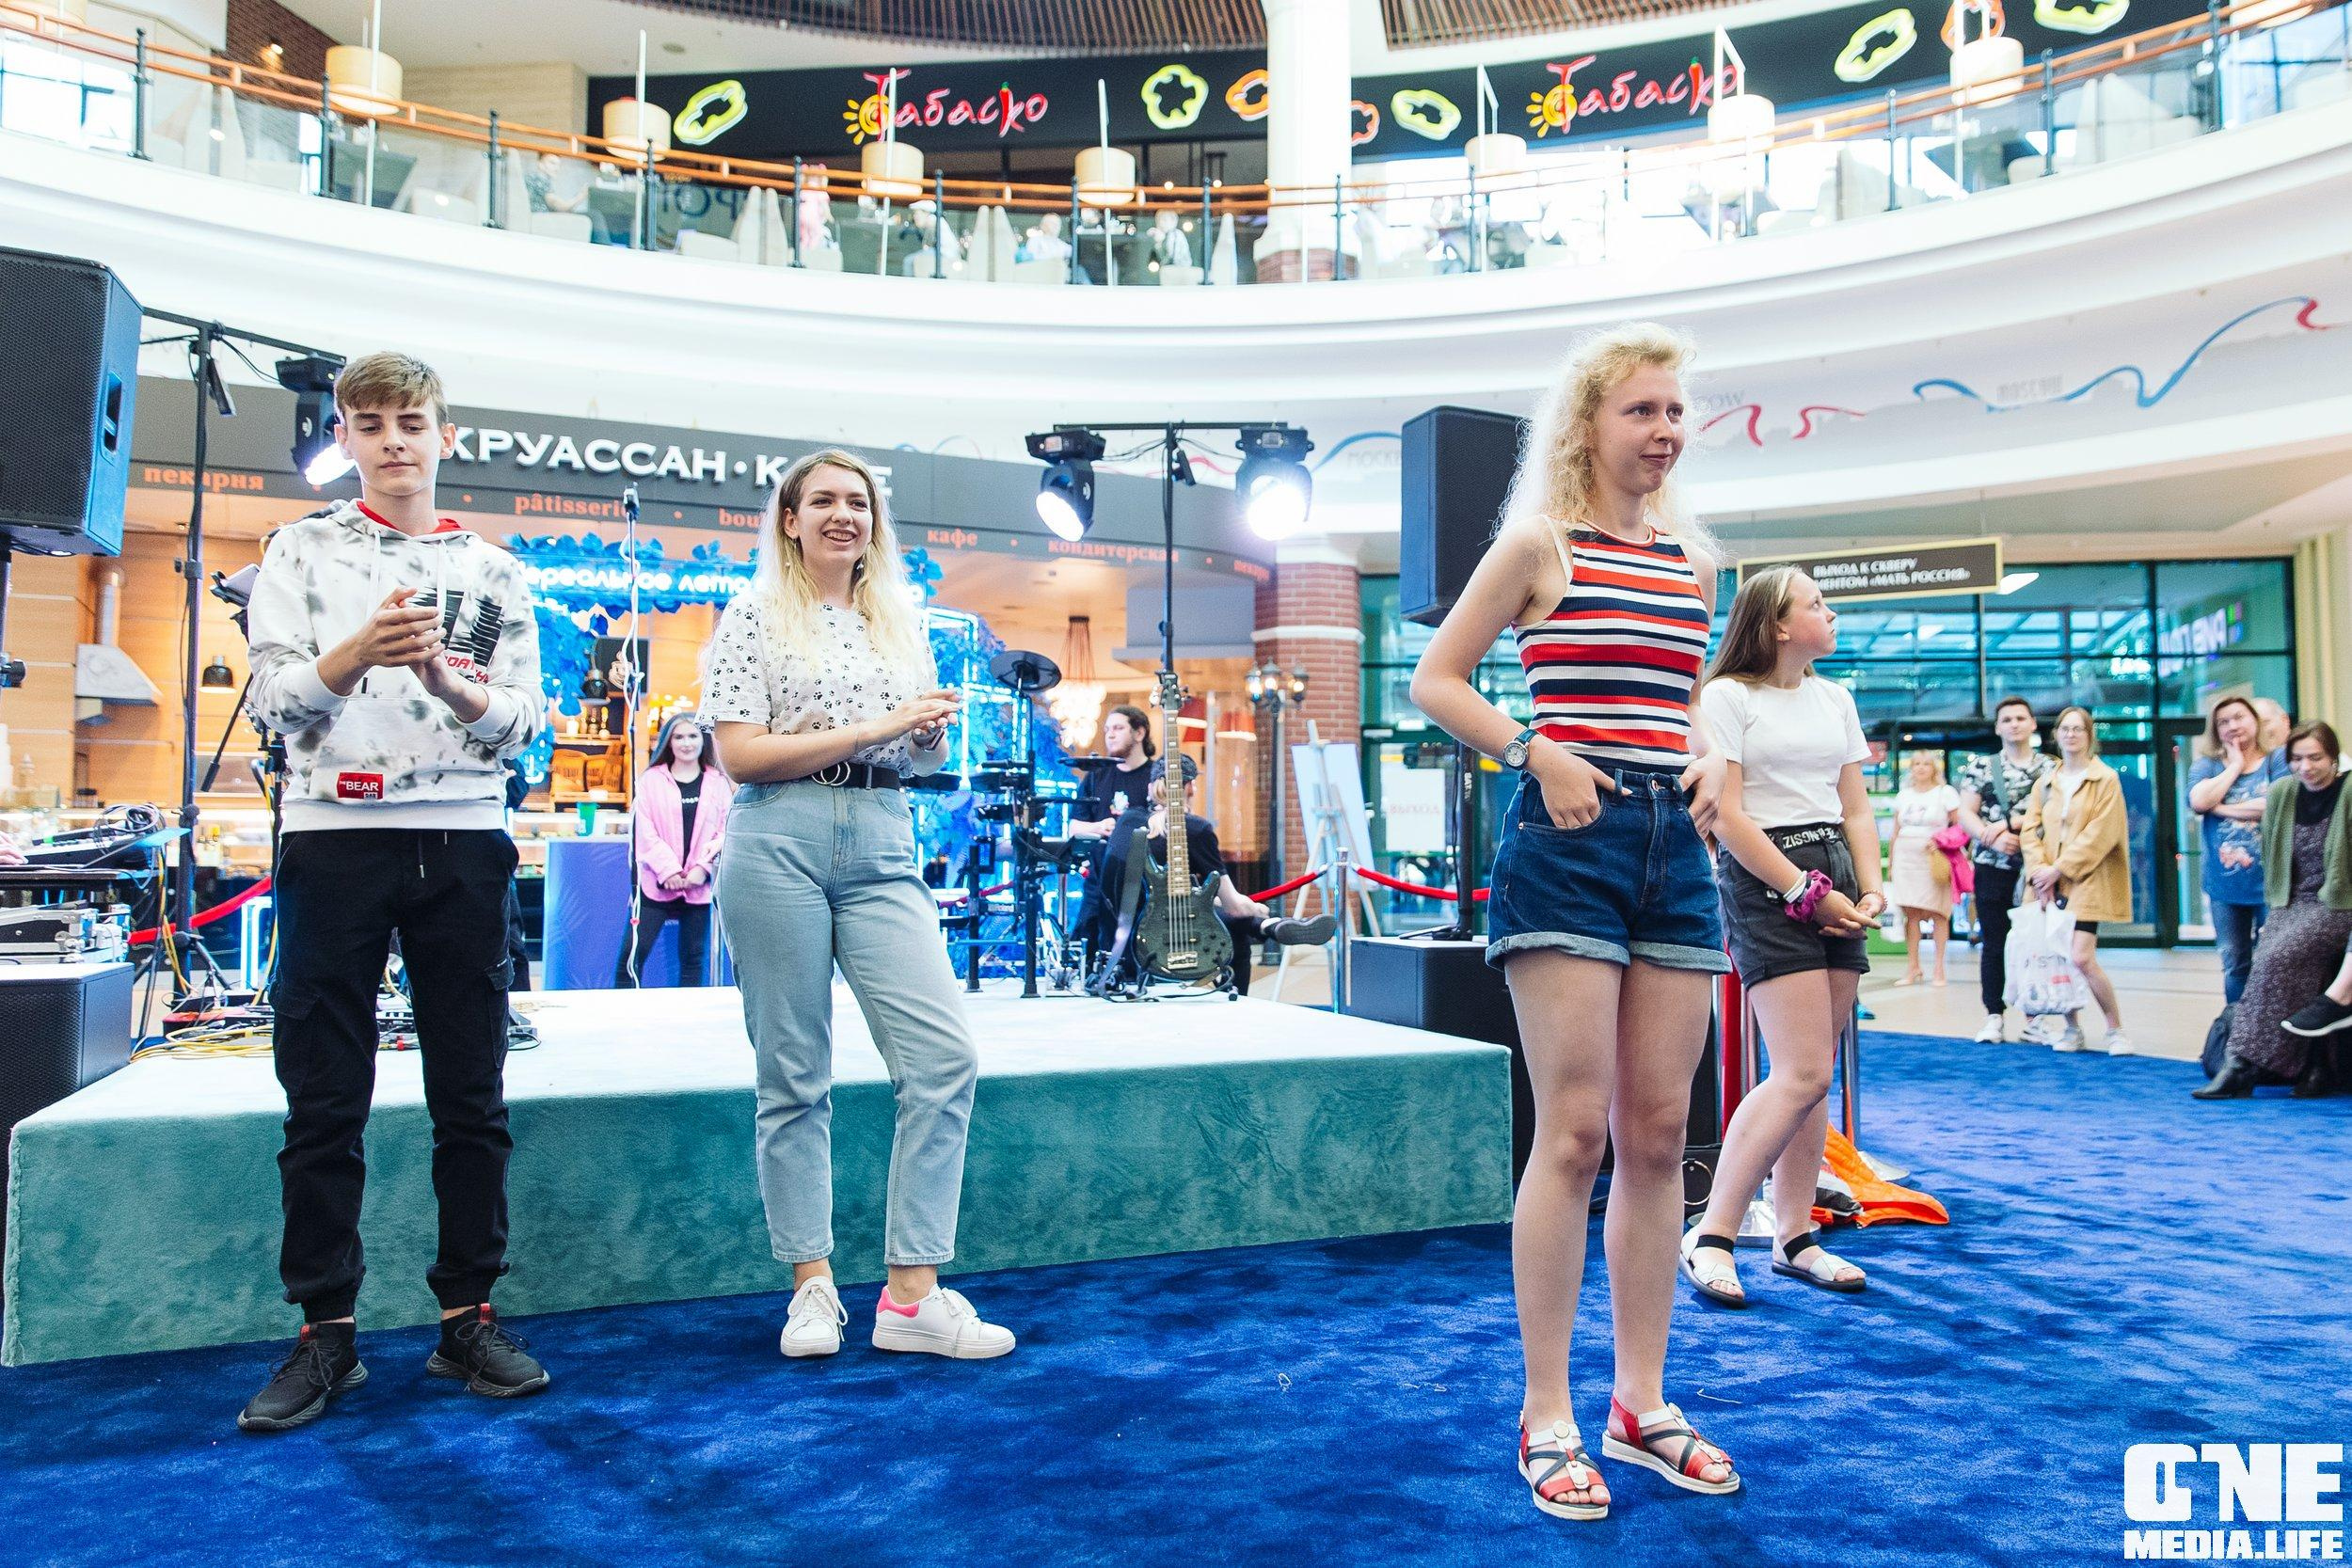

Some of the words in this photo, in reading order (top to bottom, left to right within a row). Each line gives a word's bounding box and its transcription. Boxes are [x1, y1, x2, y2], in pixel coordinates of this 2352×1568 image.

[863, 68, 1049, 143] Табаско
[1546, 55, 1738, 135] Табаско
[453, 426, 727, 484] КРУАССАН
[927, 529, 977, 549] кафе
[520, 562, 673, 592] ереальное
[345, 781, 379, 791] BEAR
